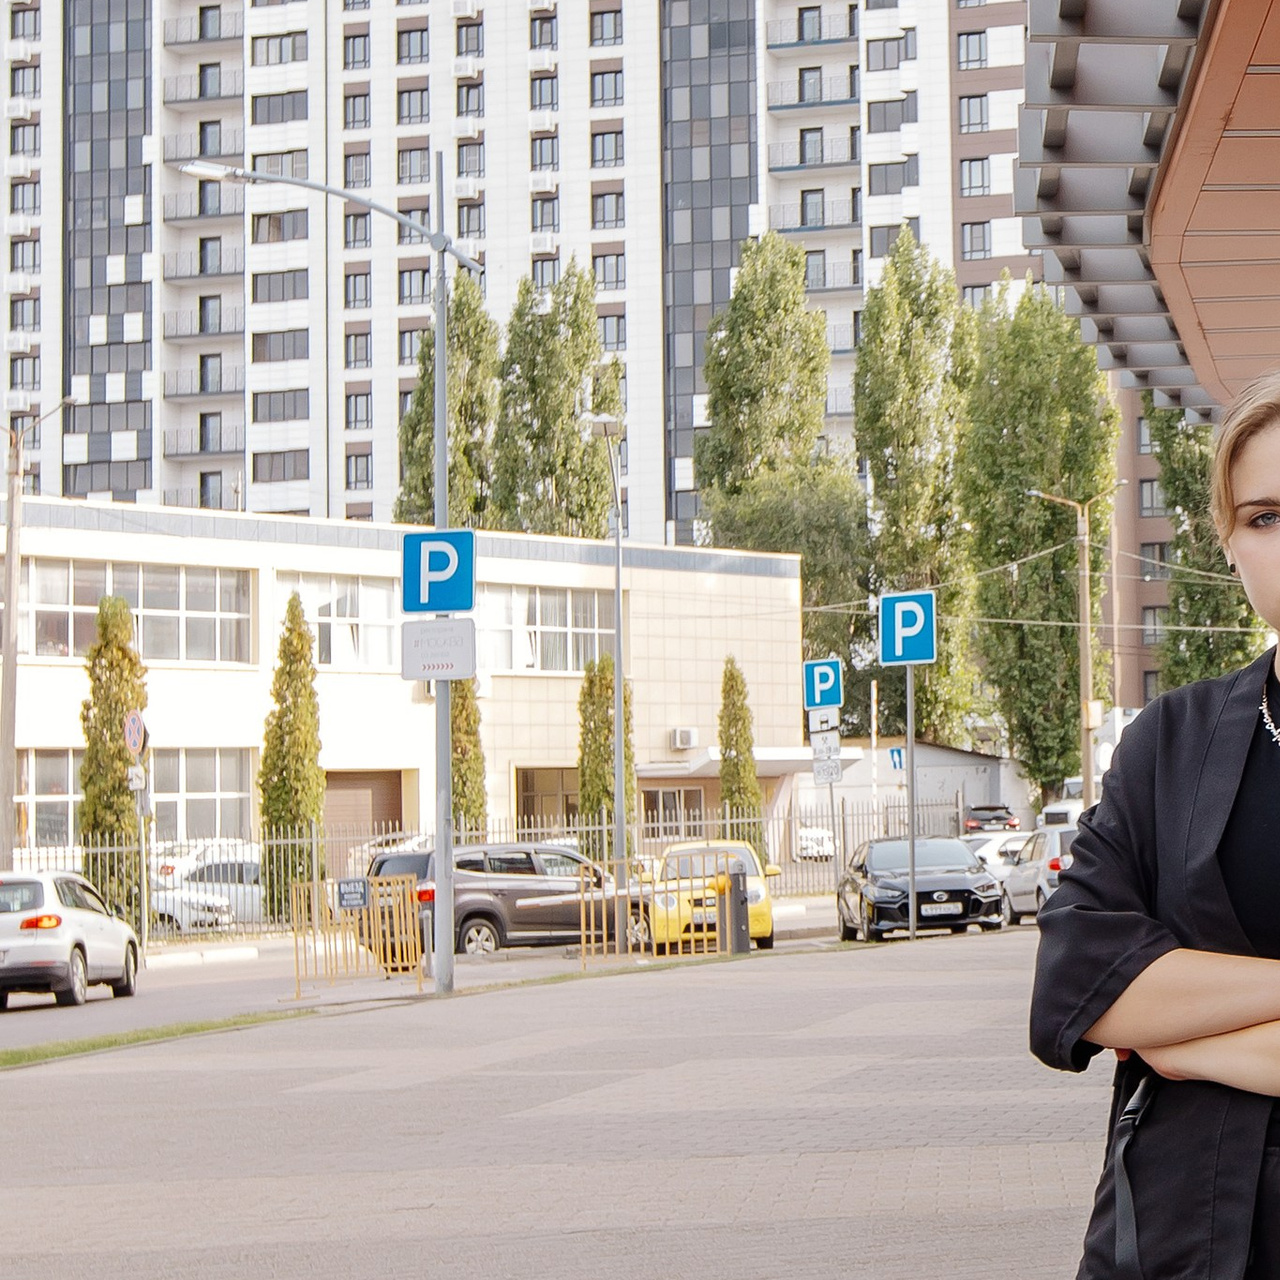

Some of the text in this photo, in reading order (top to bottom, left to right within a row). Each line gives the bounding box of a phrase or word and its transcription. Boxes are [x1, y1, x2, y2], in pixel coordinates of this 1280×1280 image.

[420, 540, 459, 604] P
[895, 601, 925, 657] P
[814, 665, 835, 704] P
